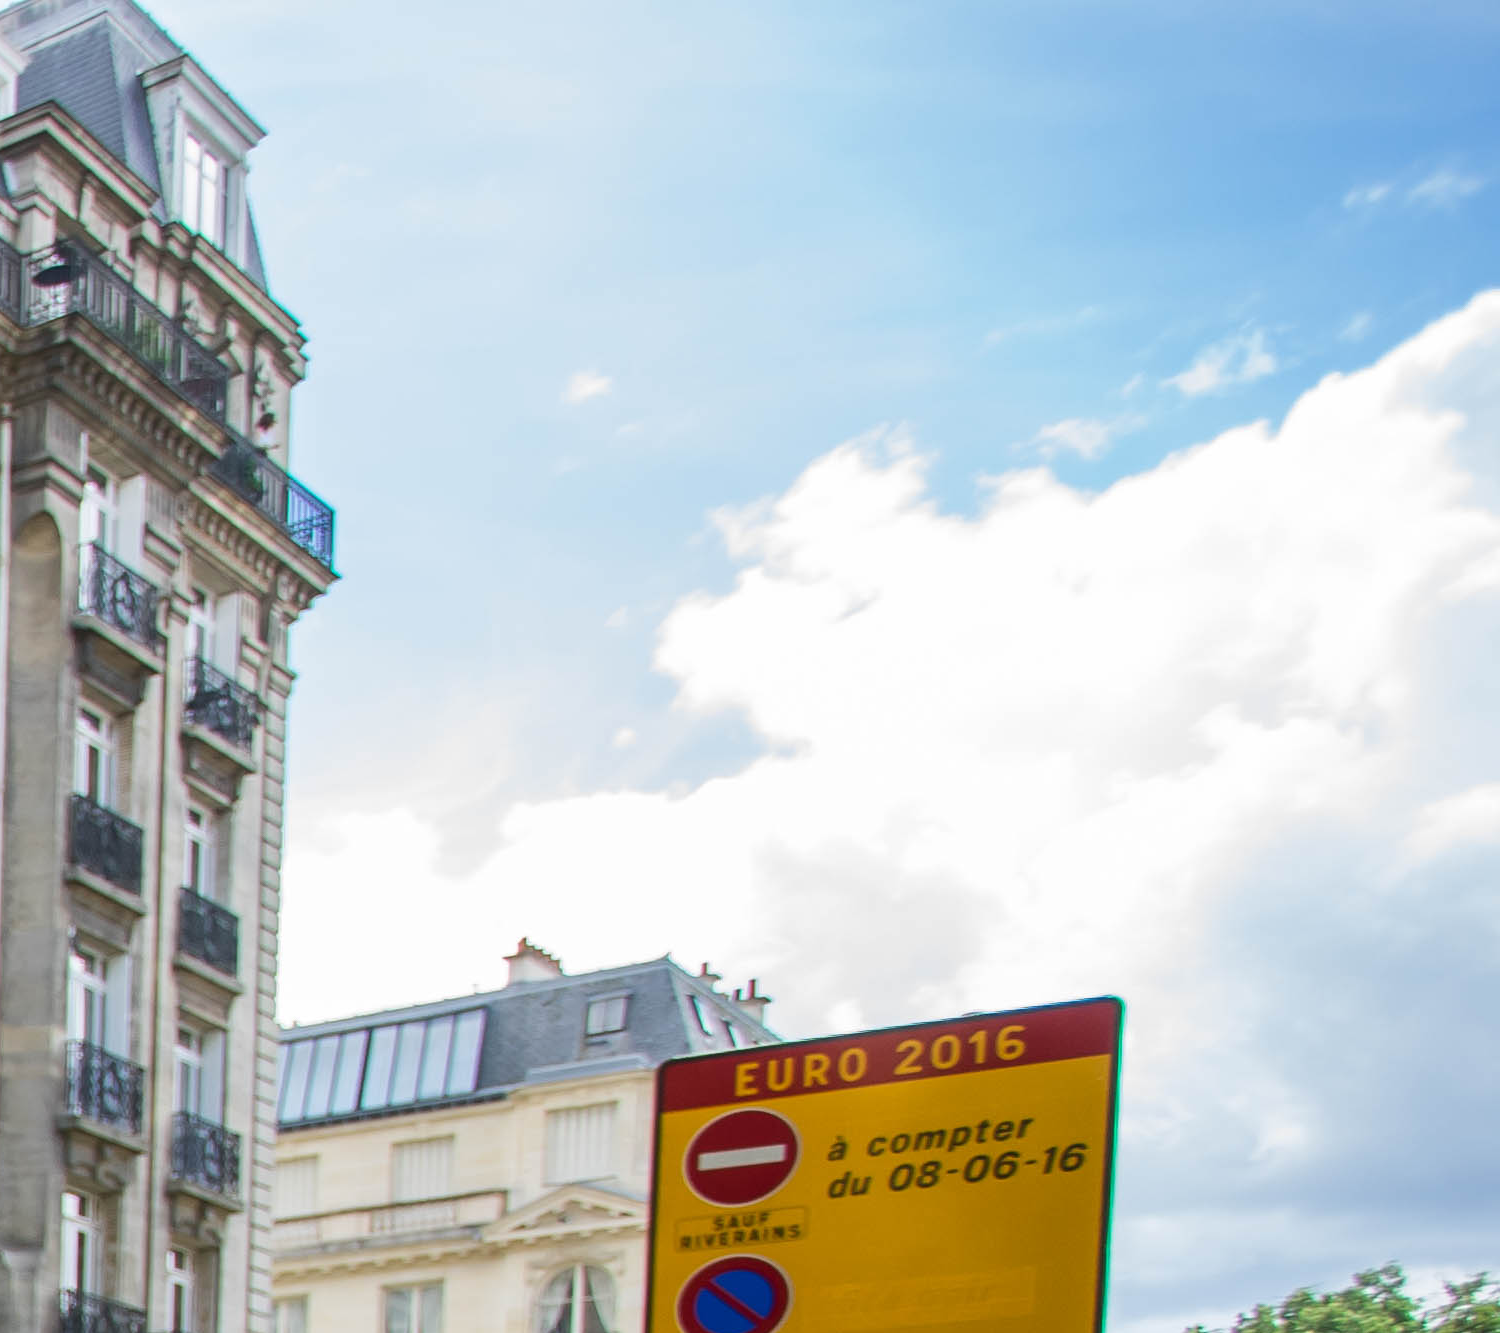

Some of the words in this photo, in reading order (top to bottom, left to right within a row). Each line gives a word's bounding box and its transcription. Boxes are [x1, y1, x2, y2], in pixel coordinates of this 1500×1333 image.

[734, 1047, 869, 1098] EURO
[893, 1024, 1027, 1076] 2016
[828, 1136, 848, 1161] à
[867, 1117, 1035, 1158] compter
[828, 1171, 871, 1199] du
[889, 1142, 1088, 1193] 08-06-16
[680, 1223, 800, 1249] RIVERAINS
[713, 1212, 769, 1232] SAUF
